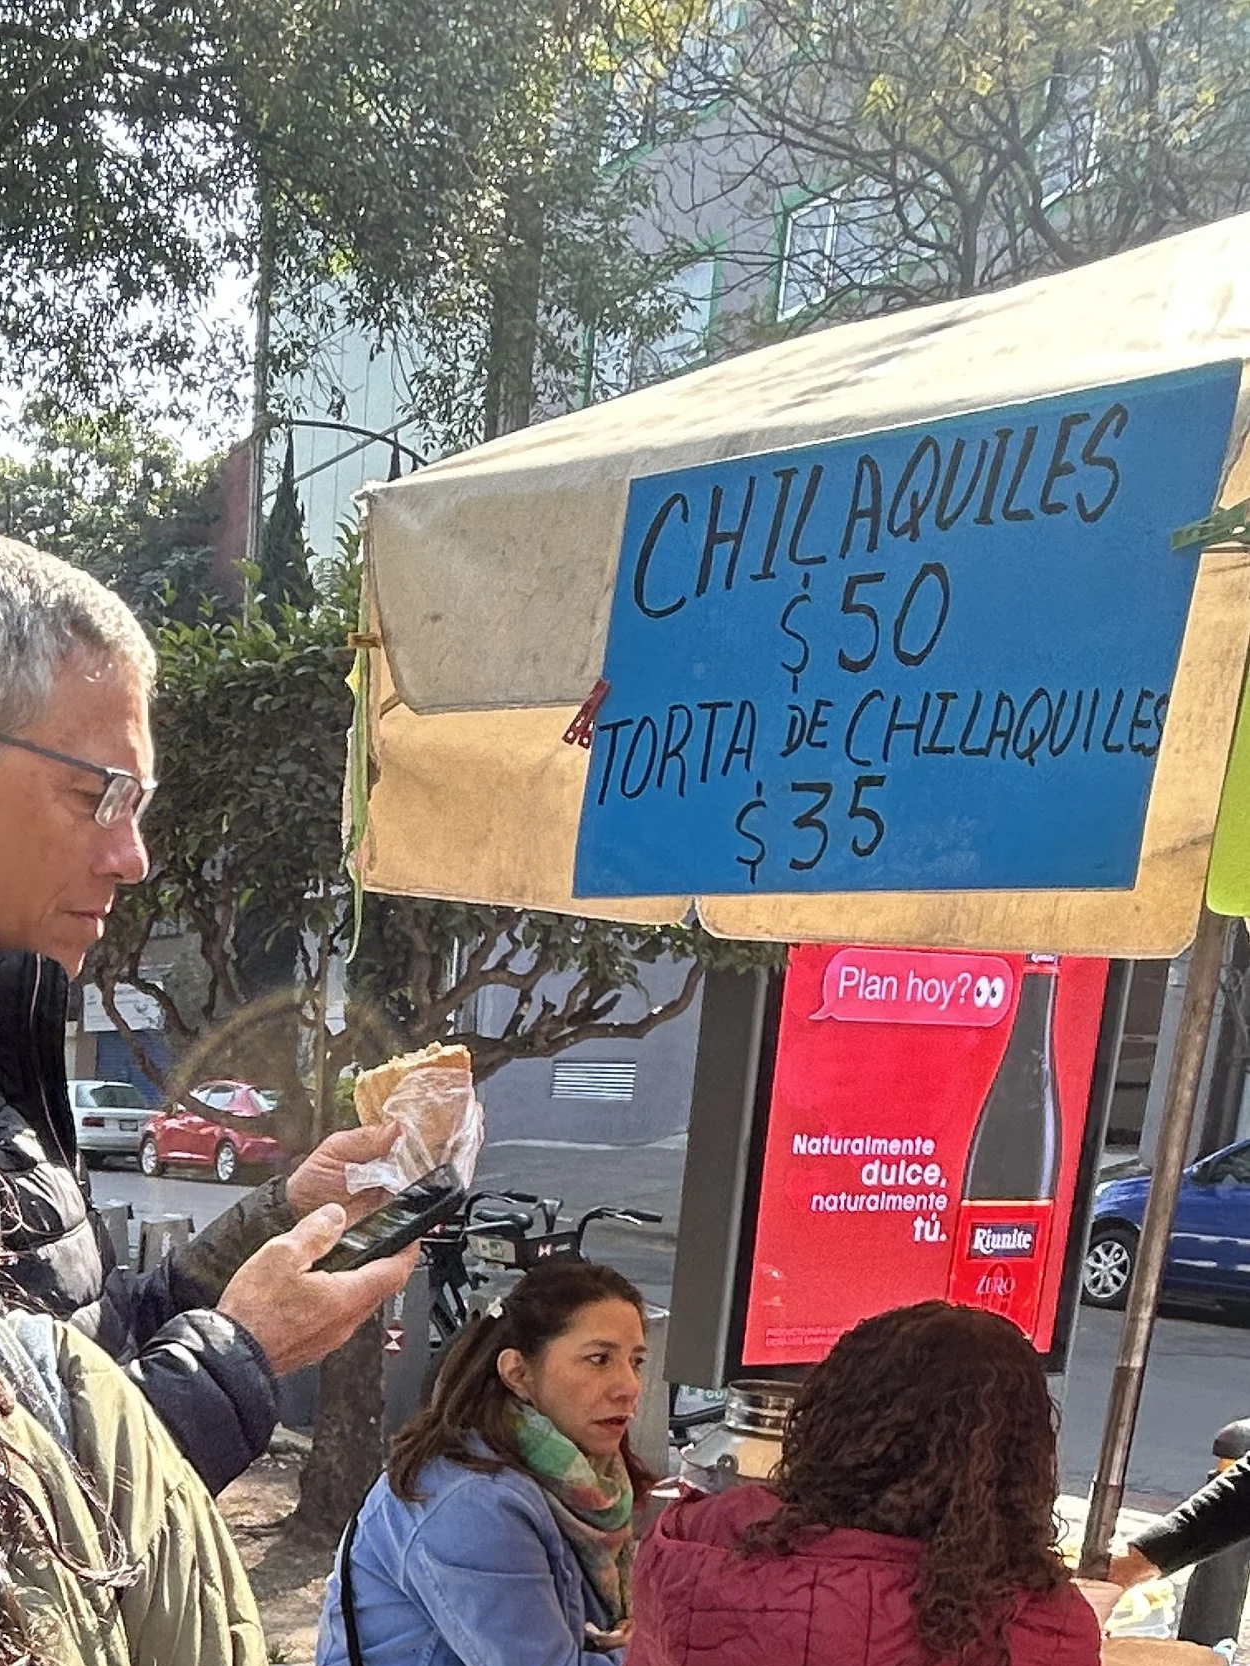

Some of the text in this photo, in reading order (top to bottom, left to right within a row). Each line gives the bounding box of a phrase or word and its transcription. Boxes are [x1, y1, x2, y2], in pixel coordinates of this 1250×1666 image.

[633, 403, 1128, 619] CHILAQUILES
[596, 687, 1171, 806] TORTA DE CHILAQUILES
[838, 966, 972, 1011] Plan hoy?
[792, 1134, 936, 1156] Naturalmente
[861, 1159, 947, 1188] dulce,
[811, 1191, 948, 1212] naturalmente
[913, 1212, 947, 1242] tú.
[972, 1228, 1033, 1255] Riunite
